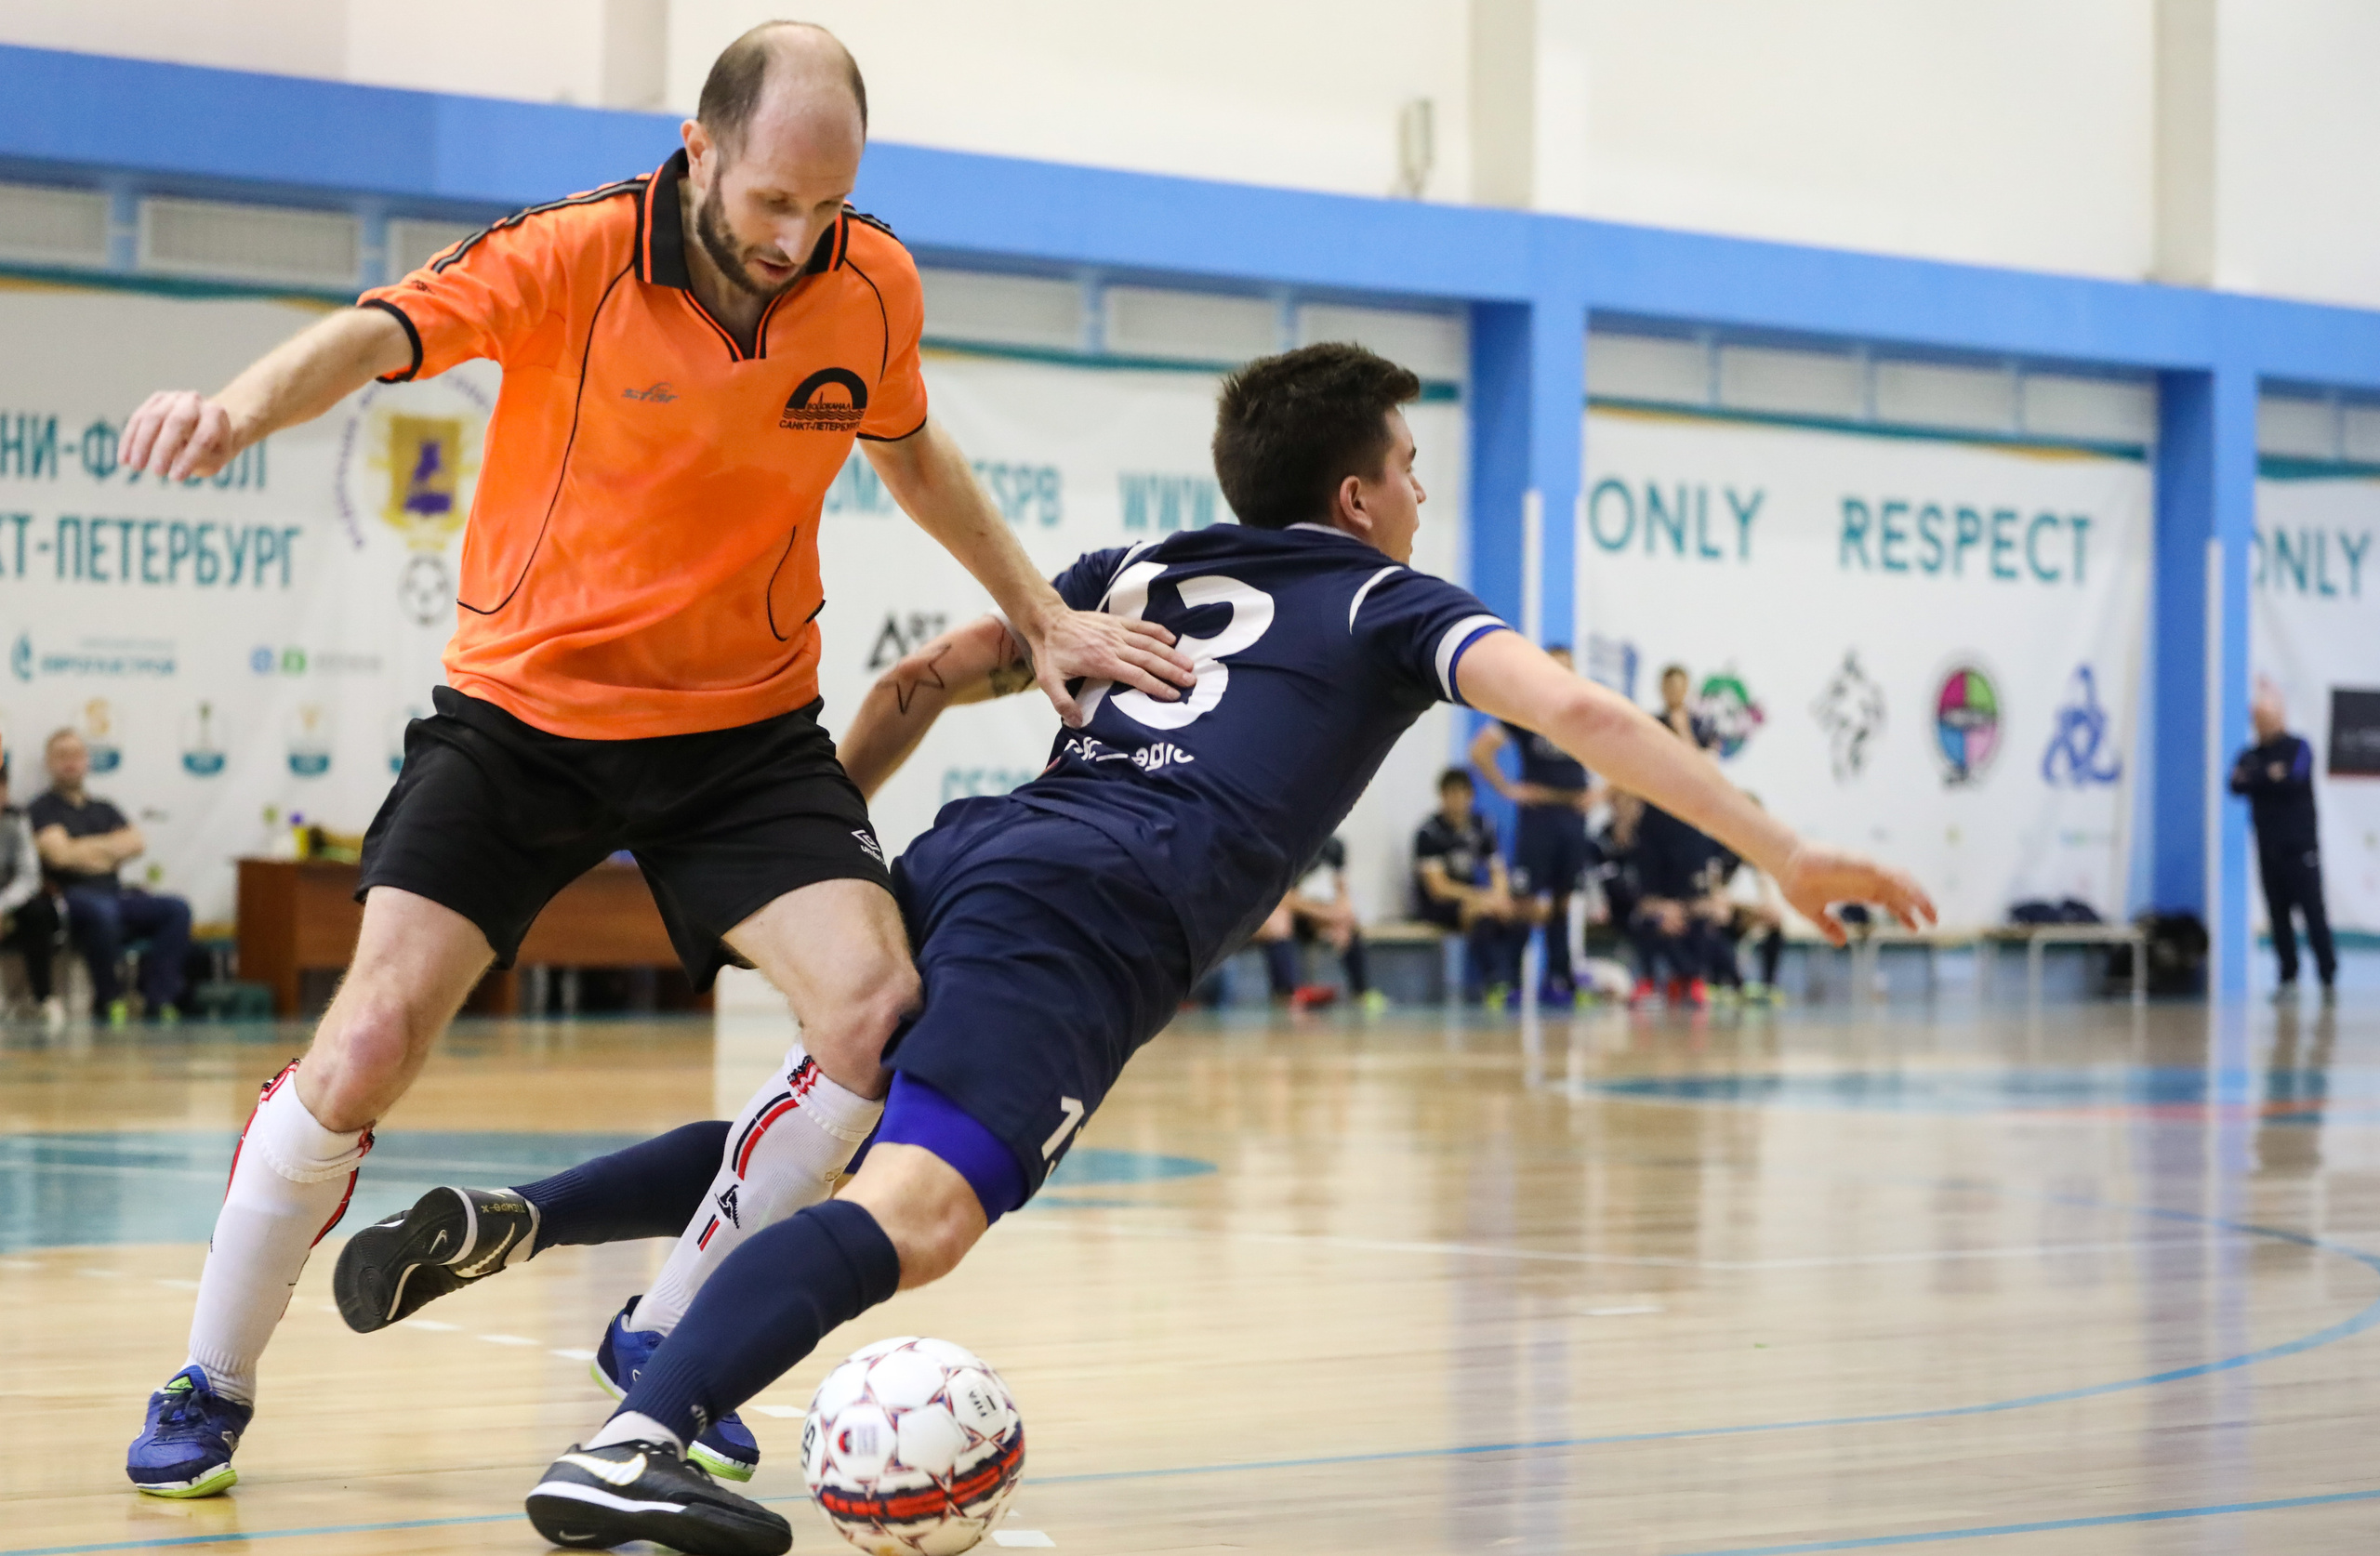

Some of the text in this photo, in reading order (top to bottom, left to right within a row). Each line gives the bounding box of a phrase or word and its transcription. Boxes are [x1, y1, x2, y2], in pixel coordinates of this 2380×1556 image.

[0, 511, 301, 587] Т-ПЕТЕРБУРГ
[1588, 477, 2091, 587] ONLY RESPECT
